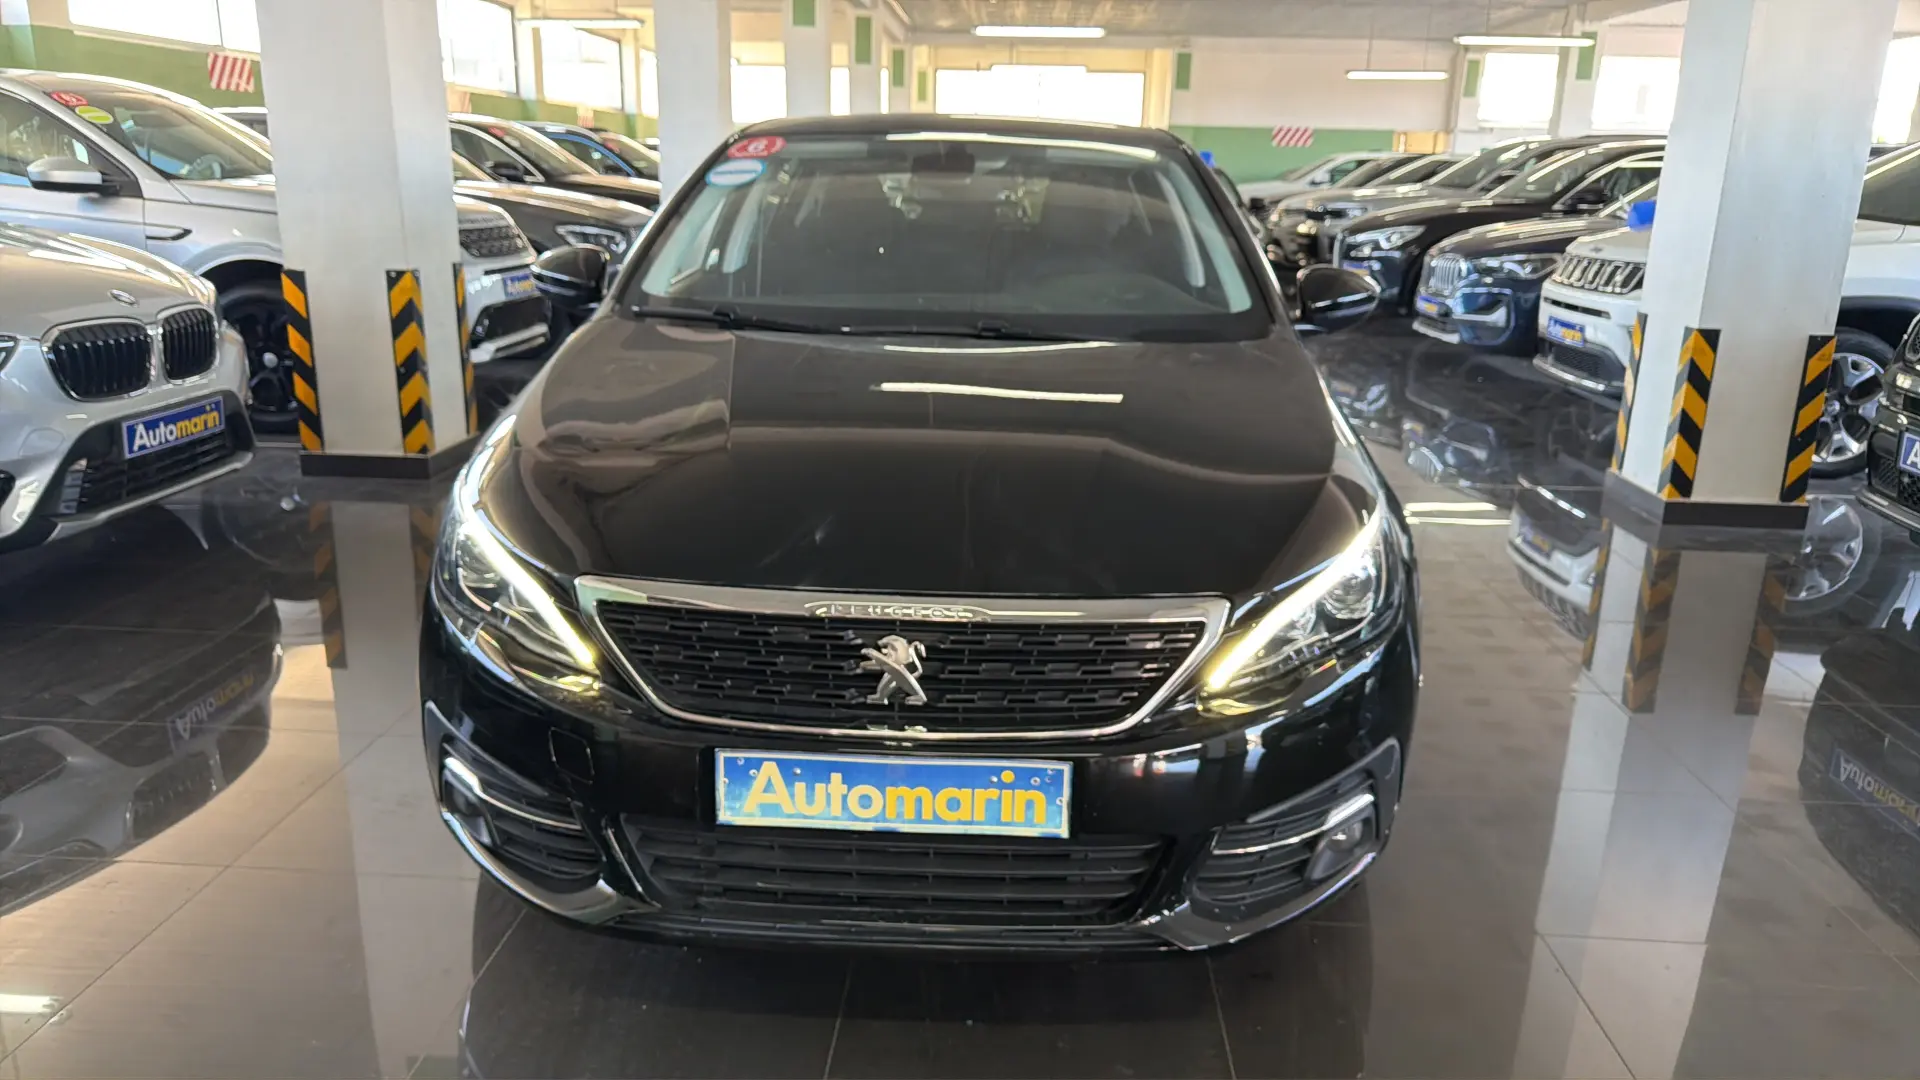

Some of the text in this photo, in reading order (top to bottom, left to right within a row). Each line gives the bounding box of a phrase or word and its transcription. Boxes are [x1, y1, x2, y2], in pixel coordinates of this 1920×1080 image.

[133, 404, 220, 452] Automarin
[831, 604, 965, 620] PEUGEOT
[744, 761, 1047, 823] Automarin
